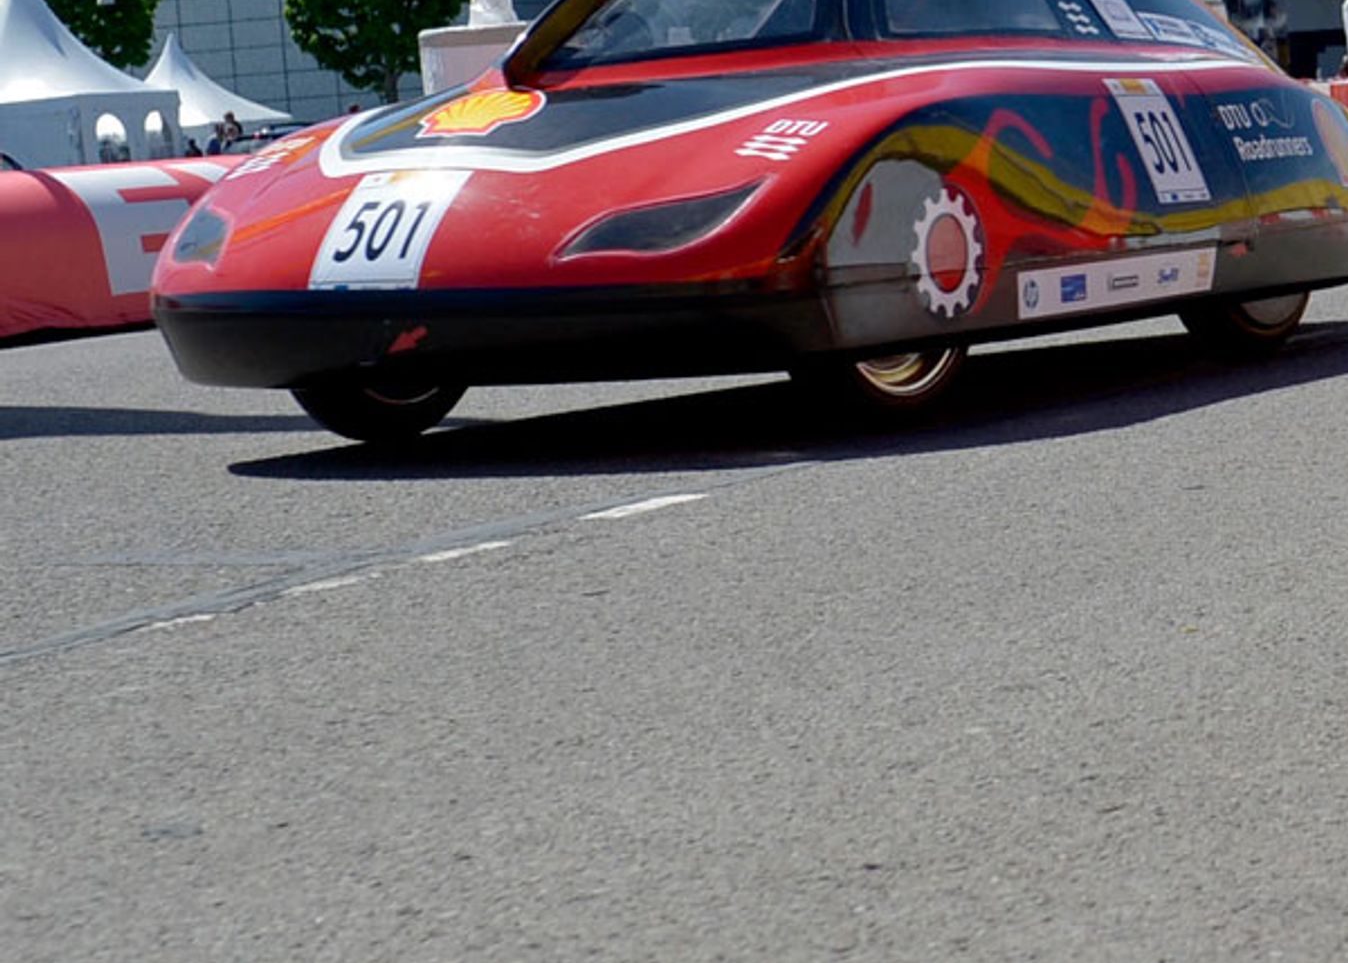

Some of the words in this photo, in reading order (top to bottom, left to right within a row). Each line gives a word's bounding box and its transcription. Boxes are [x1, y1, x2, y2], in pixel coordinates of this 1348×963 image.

[762, 118, 829, 137] DTU
[1217, 103, 1253, 131] DTU
[1133, 110, 1193, 175] 501
[332, 199, 433, 263] 501
